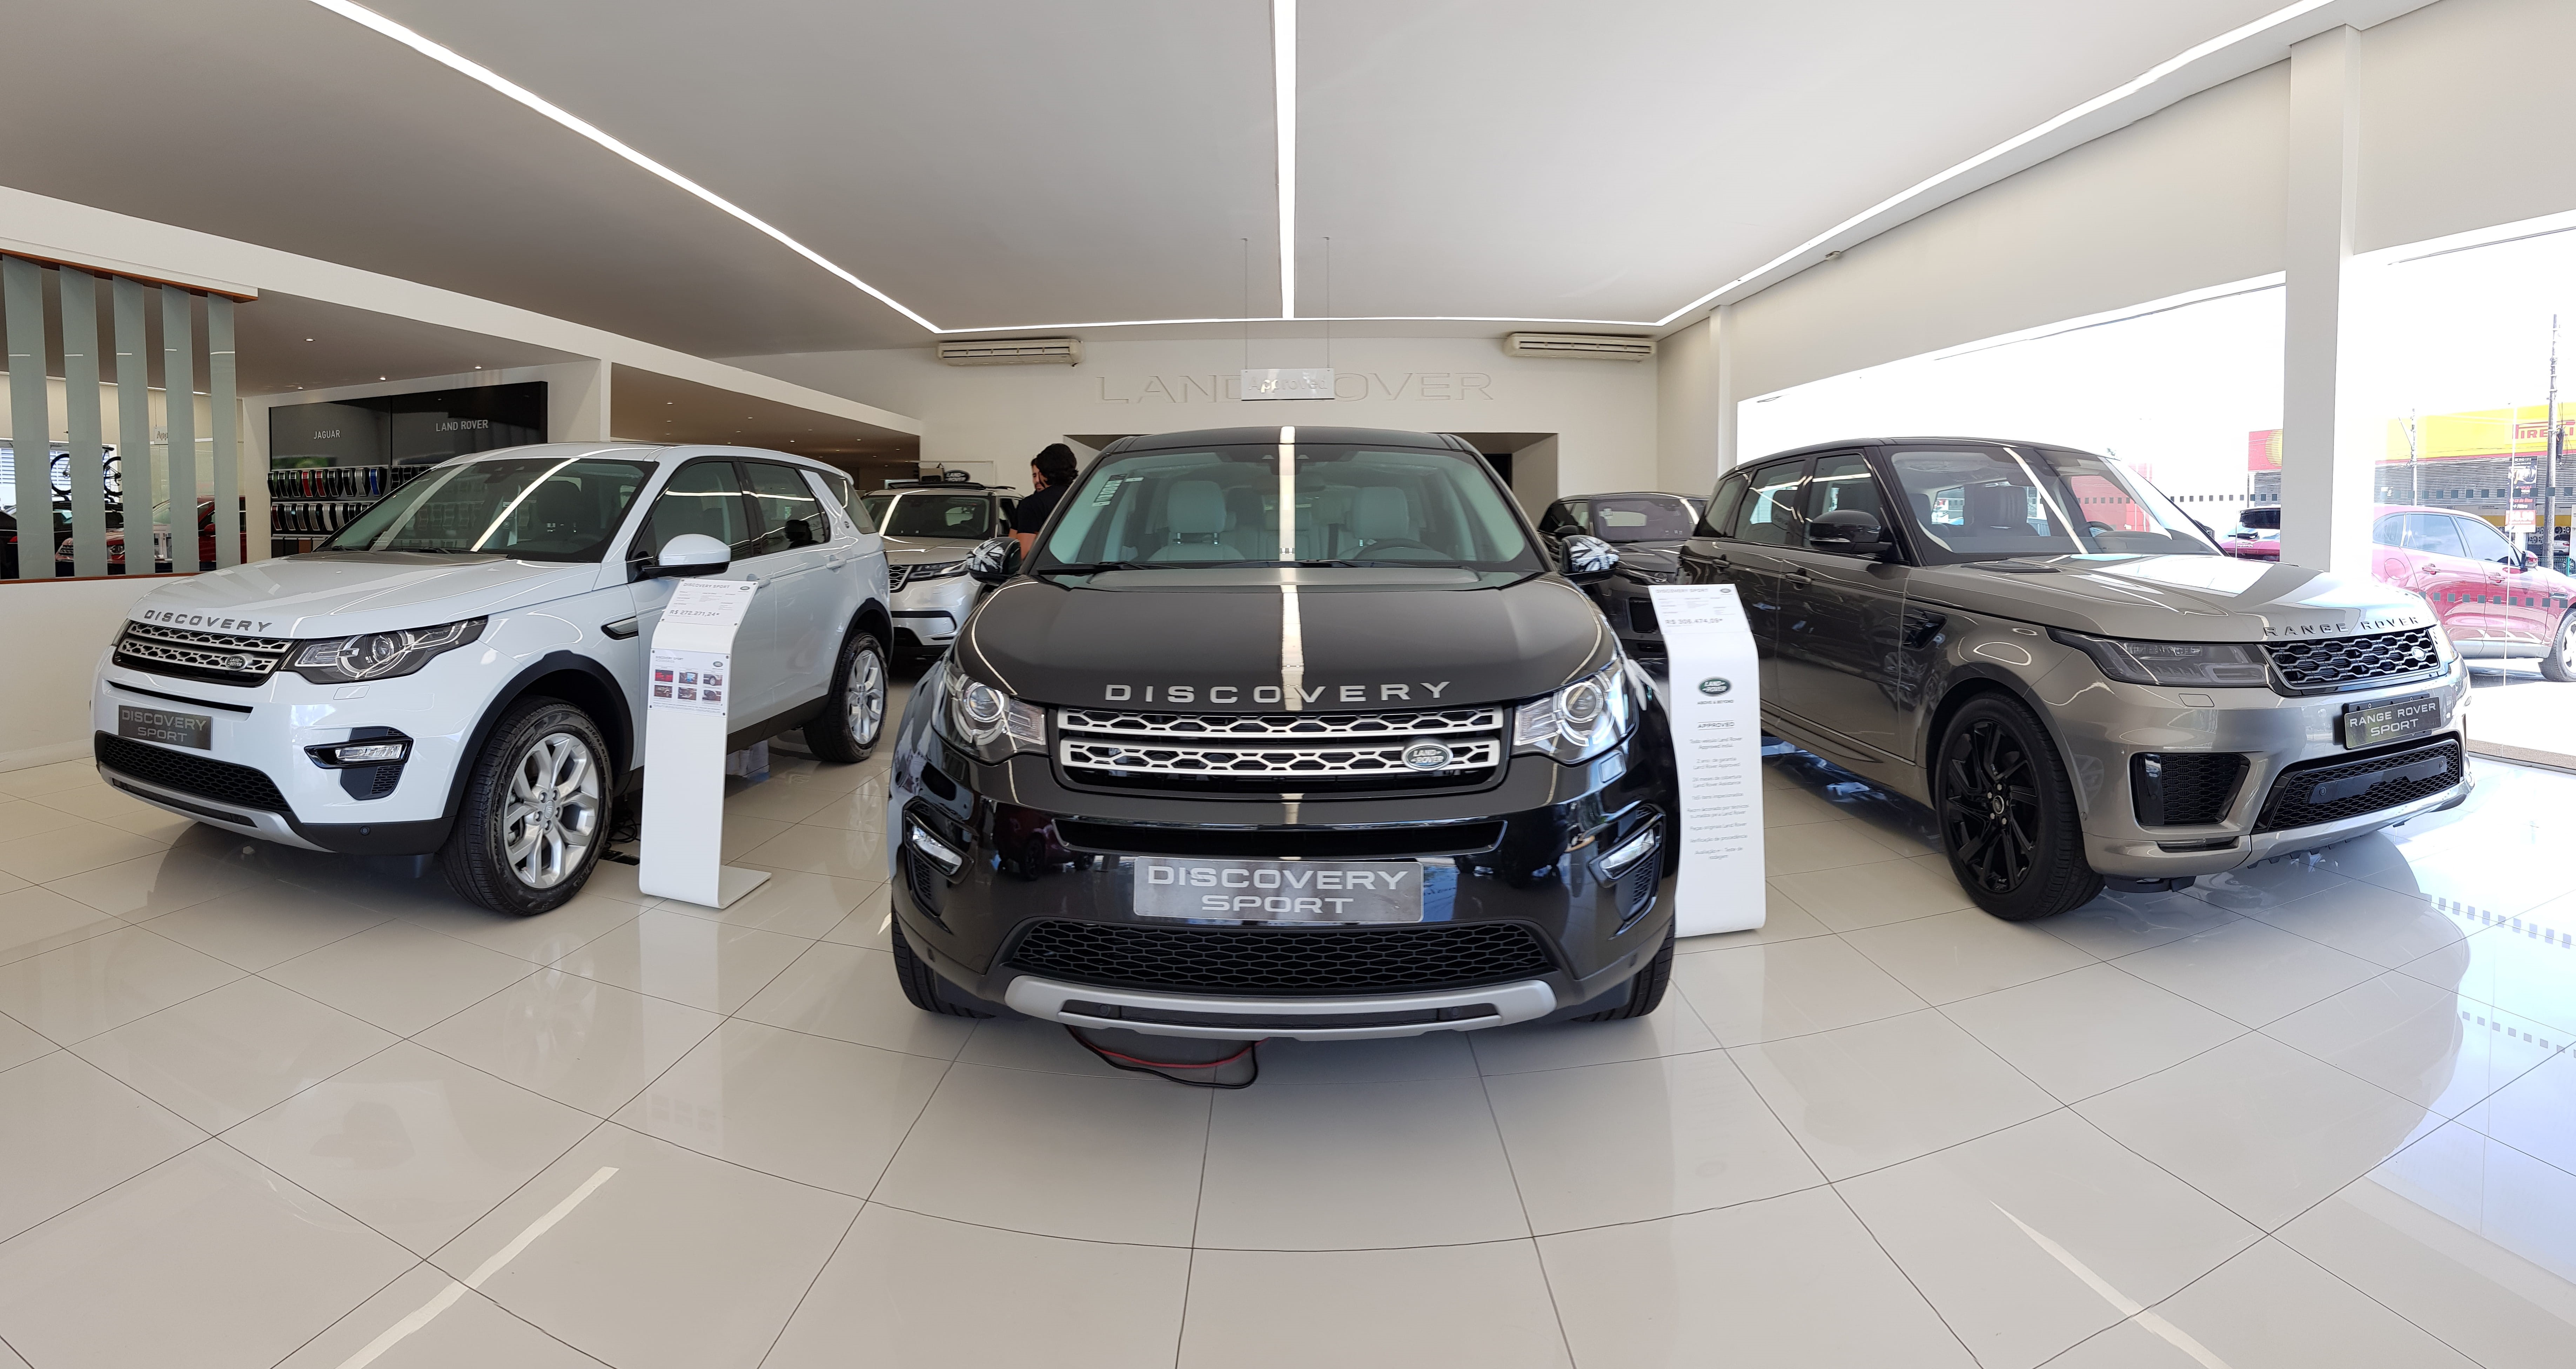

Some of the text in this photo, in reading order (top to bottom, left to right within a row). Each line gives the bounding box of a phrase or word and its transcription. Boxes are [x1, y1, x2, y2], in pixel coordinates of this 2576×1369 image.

[1249, 375, 1328, 393] Approved
[1334, 372, 1494, 402] OVER
[157, 431, 168, 440] App
[314, 430, 341, 439] JAGUAR
[436, 419, 489, 432] LAND ROVER
[2513, 419, 2575, 439] PIREI
[144, 610, 272, 632] DISCOVERY
[2263, 616, 2419, 636] RANGE ROVER
[1105, 681, 1450, 703] DISCOVERY
[122, 709, 207, 731] DISCOVERY
[2350, 703, 2436, 727] RANGE ROVER
[138, 727, 187, 742] SPORT
[2370, 719, 2419, 736] SPORT
[1148, 865, 1408, 890] DISCOVERY
[1201, 895, 1354, 914] SPORT
